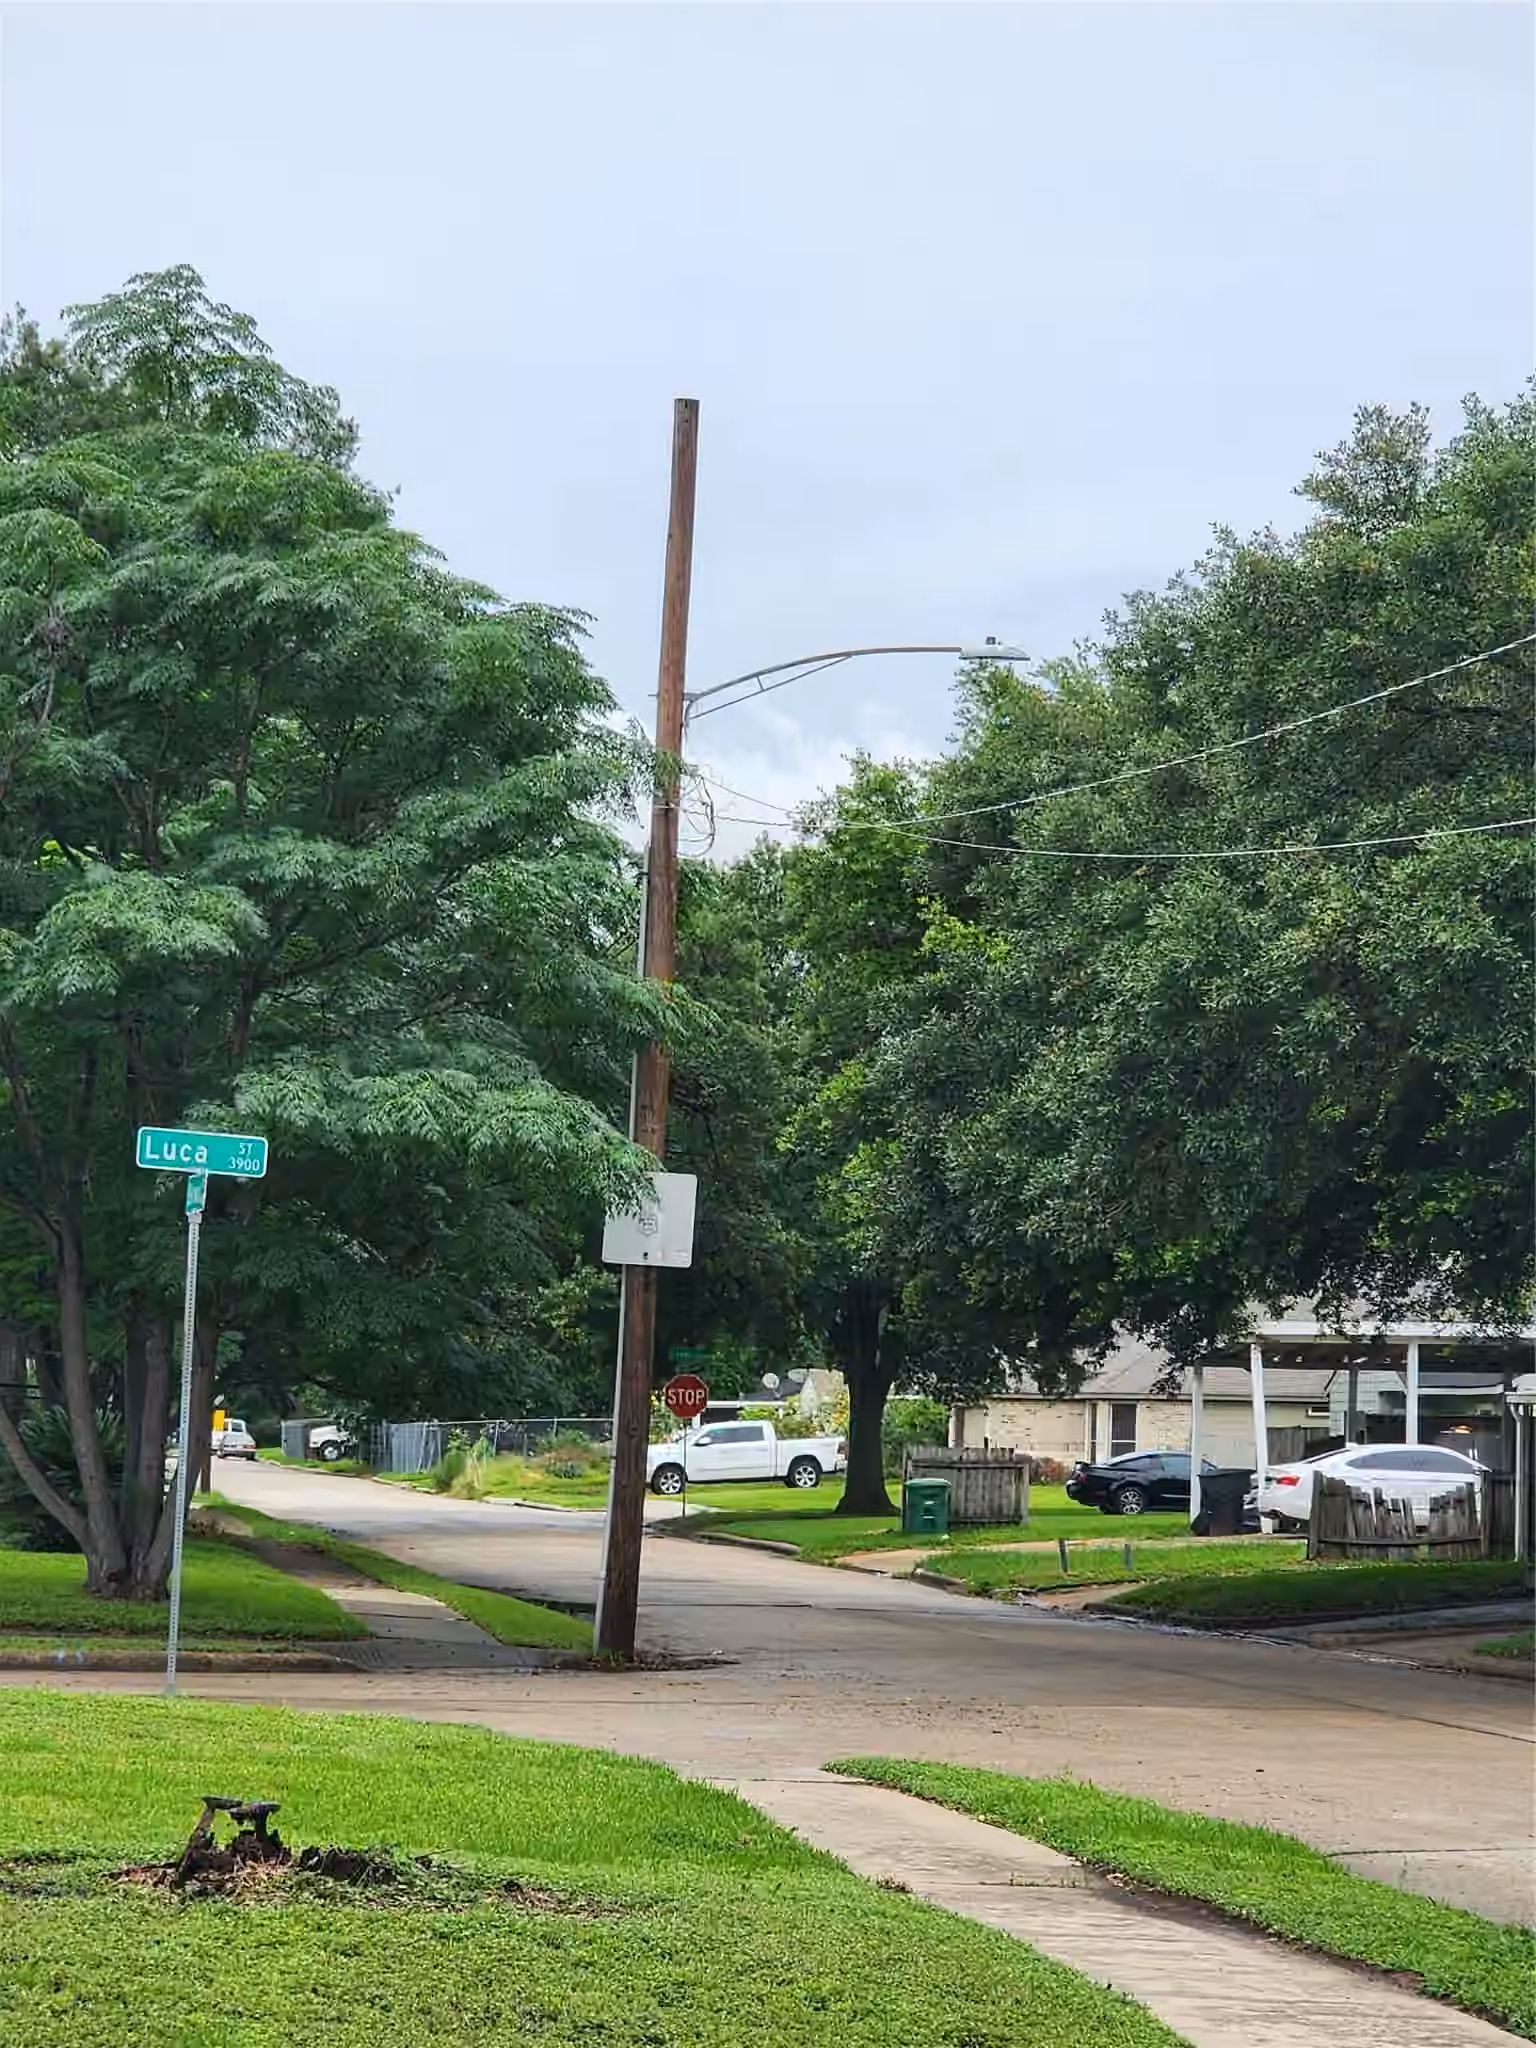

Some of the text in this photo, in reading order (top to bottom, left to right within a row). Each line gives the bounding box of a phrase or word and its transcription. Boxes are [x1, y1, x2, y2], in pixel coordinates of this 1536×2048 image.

[145, 1135, 254, 1163] Luca ST
[228, 1156, 261, 1171] 3900
[667, 1388, 705, 1406] STOP
